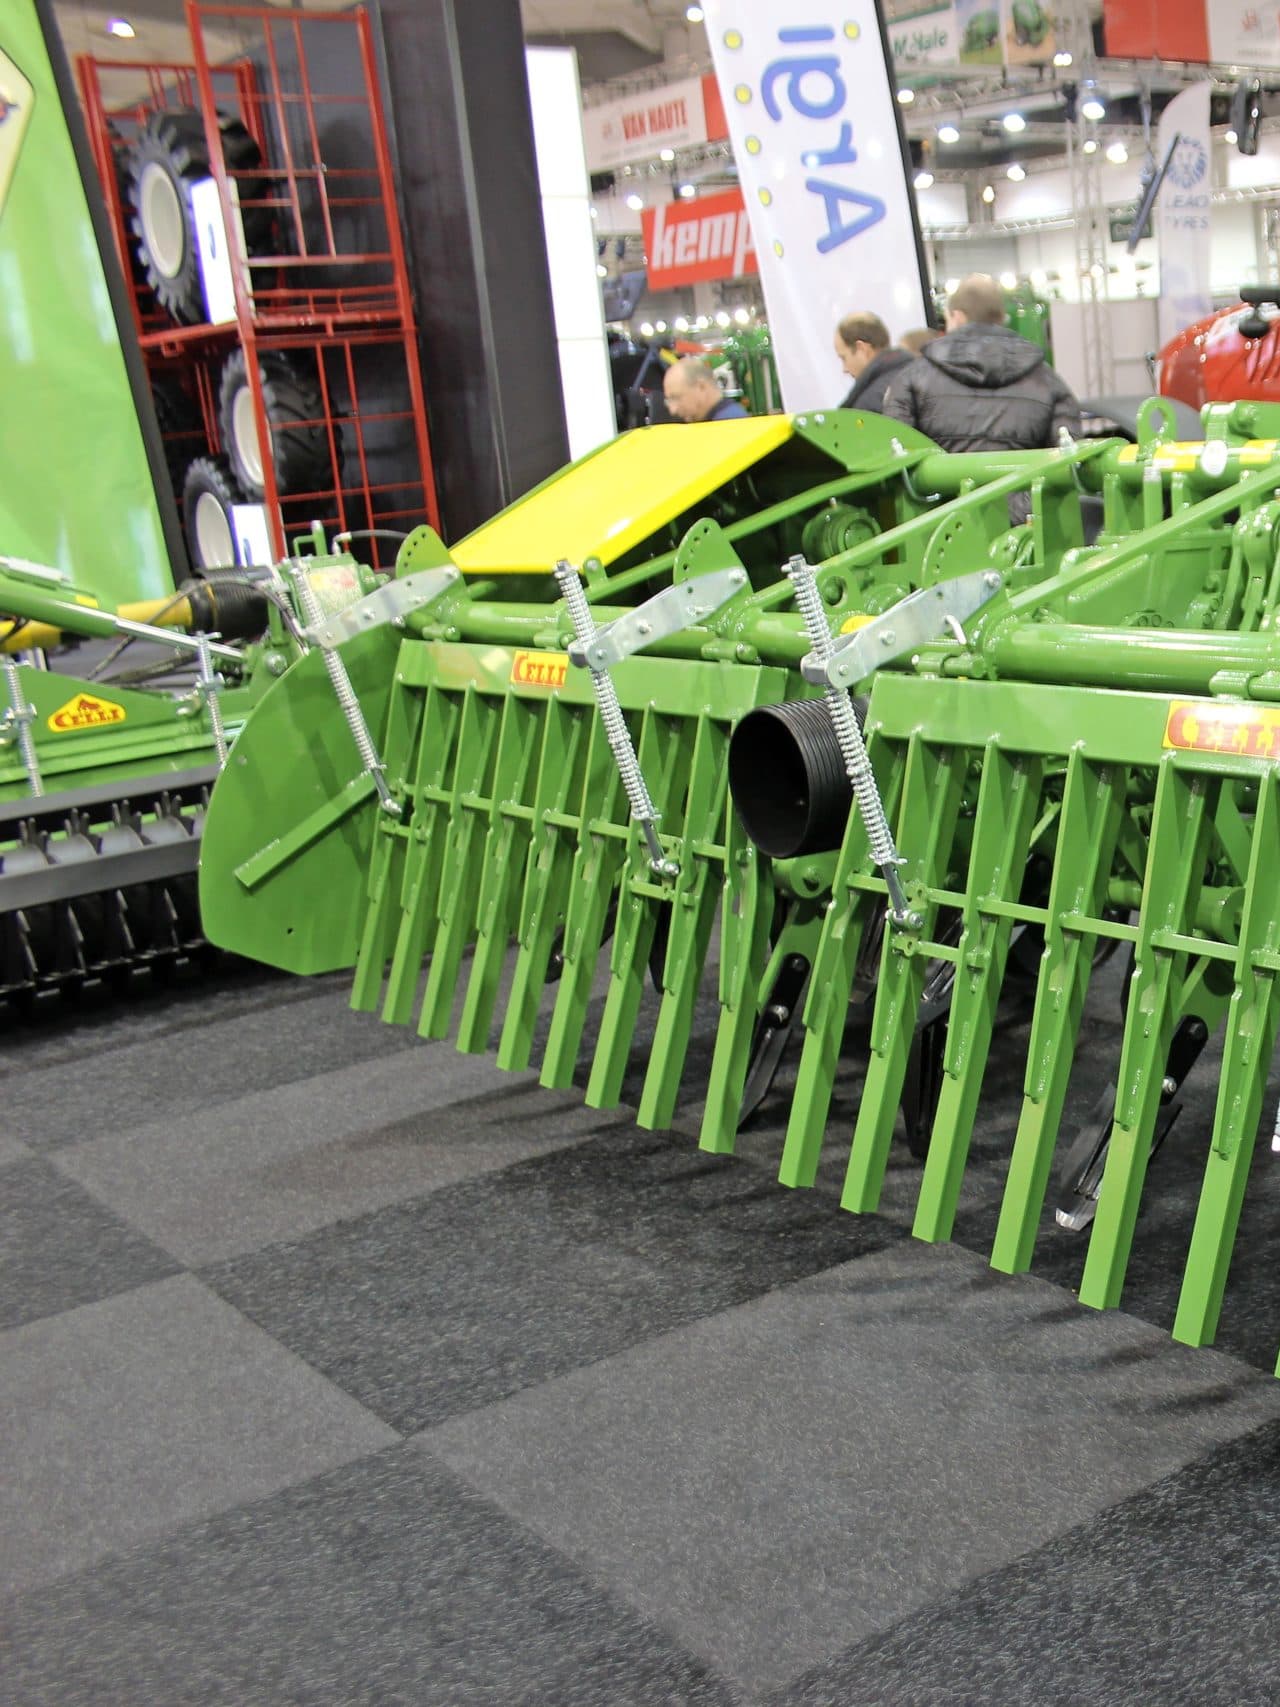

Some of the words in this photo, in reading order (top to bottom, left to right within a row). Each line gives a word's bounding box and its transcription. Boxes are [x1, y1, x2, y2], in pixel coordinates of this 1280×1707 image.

[894, 27, 949, 57] MHale
[622, 111, 647, 141] VAN
[513, 653, 567, 686] CELLI
[54, 709, 119, 728] CELLI
